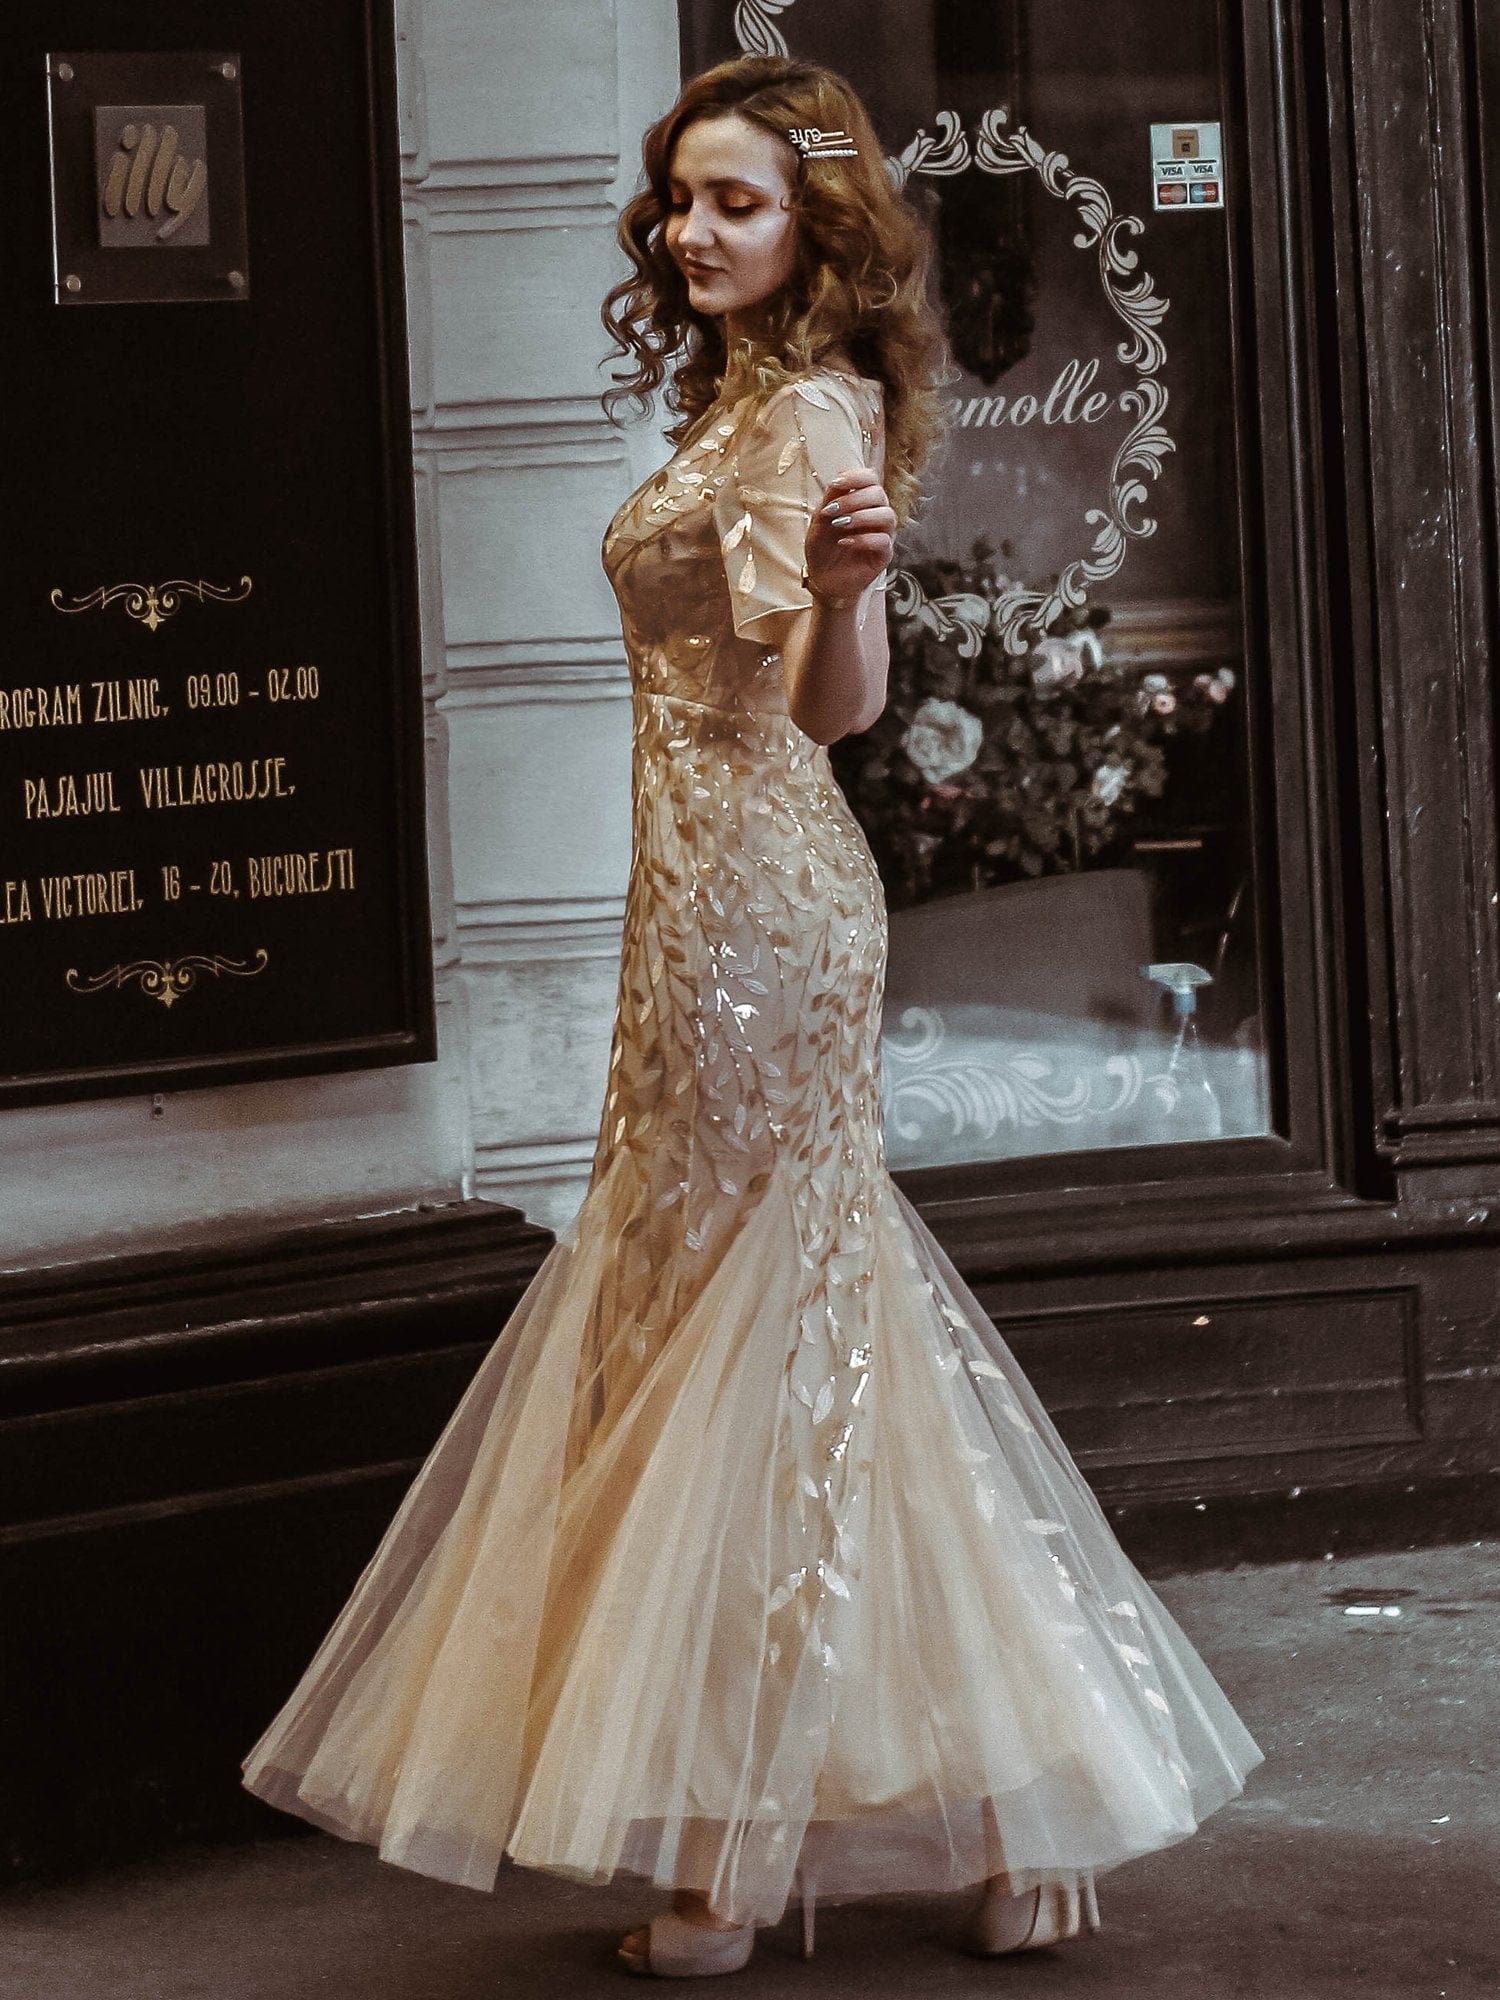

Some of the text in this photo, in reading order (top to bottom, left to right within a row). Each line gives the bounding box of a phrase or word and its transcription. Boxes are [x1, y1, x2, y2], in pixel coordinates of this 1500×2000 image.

[104, 123, 208, 240] illy
[1162, 166, 1183, 175] VISA
[1193, 165, 1214, 173] VISA
[91, 678, 170, 723] ZILNIC,
[187, 672, 239, 709] 09.00
[268, 666, 319, 702] 02.00
[24, 757, 296, 820] PASAJUL VILLACROSSE,
[41, 869, 145, 919] VICTORIEI,
[161, 866, 180, 901] 16
[210, 861, 240, 899] 20,
[249, 849, 355, 899] BUCURESTI
